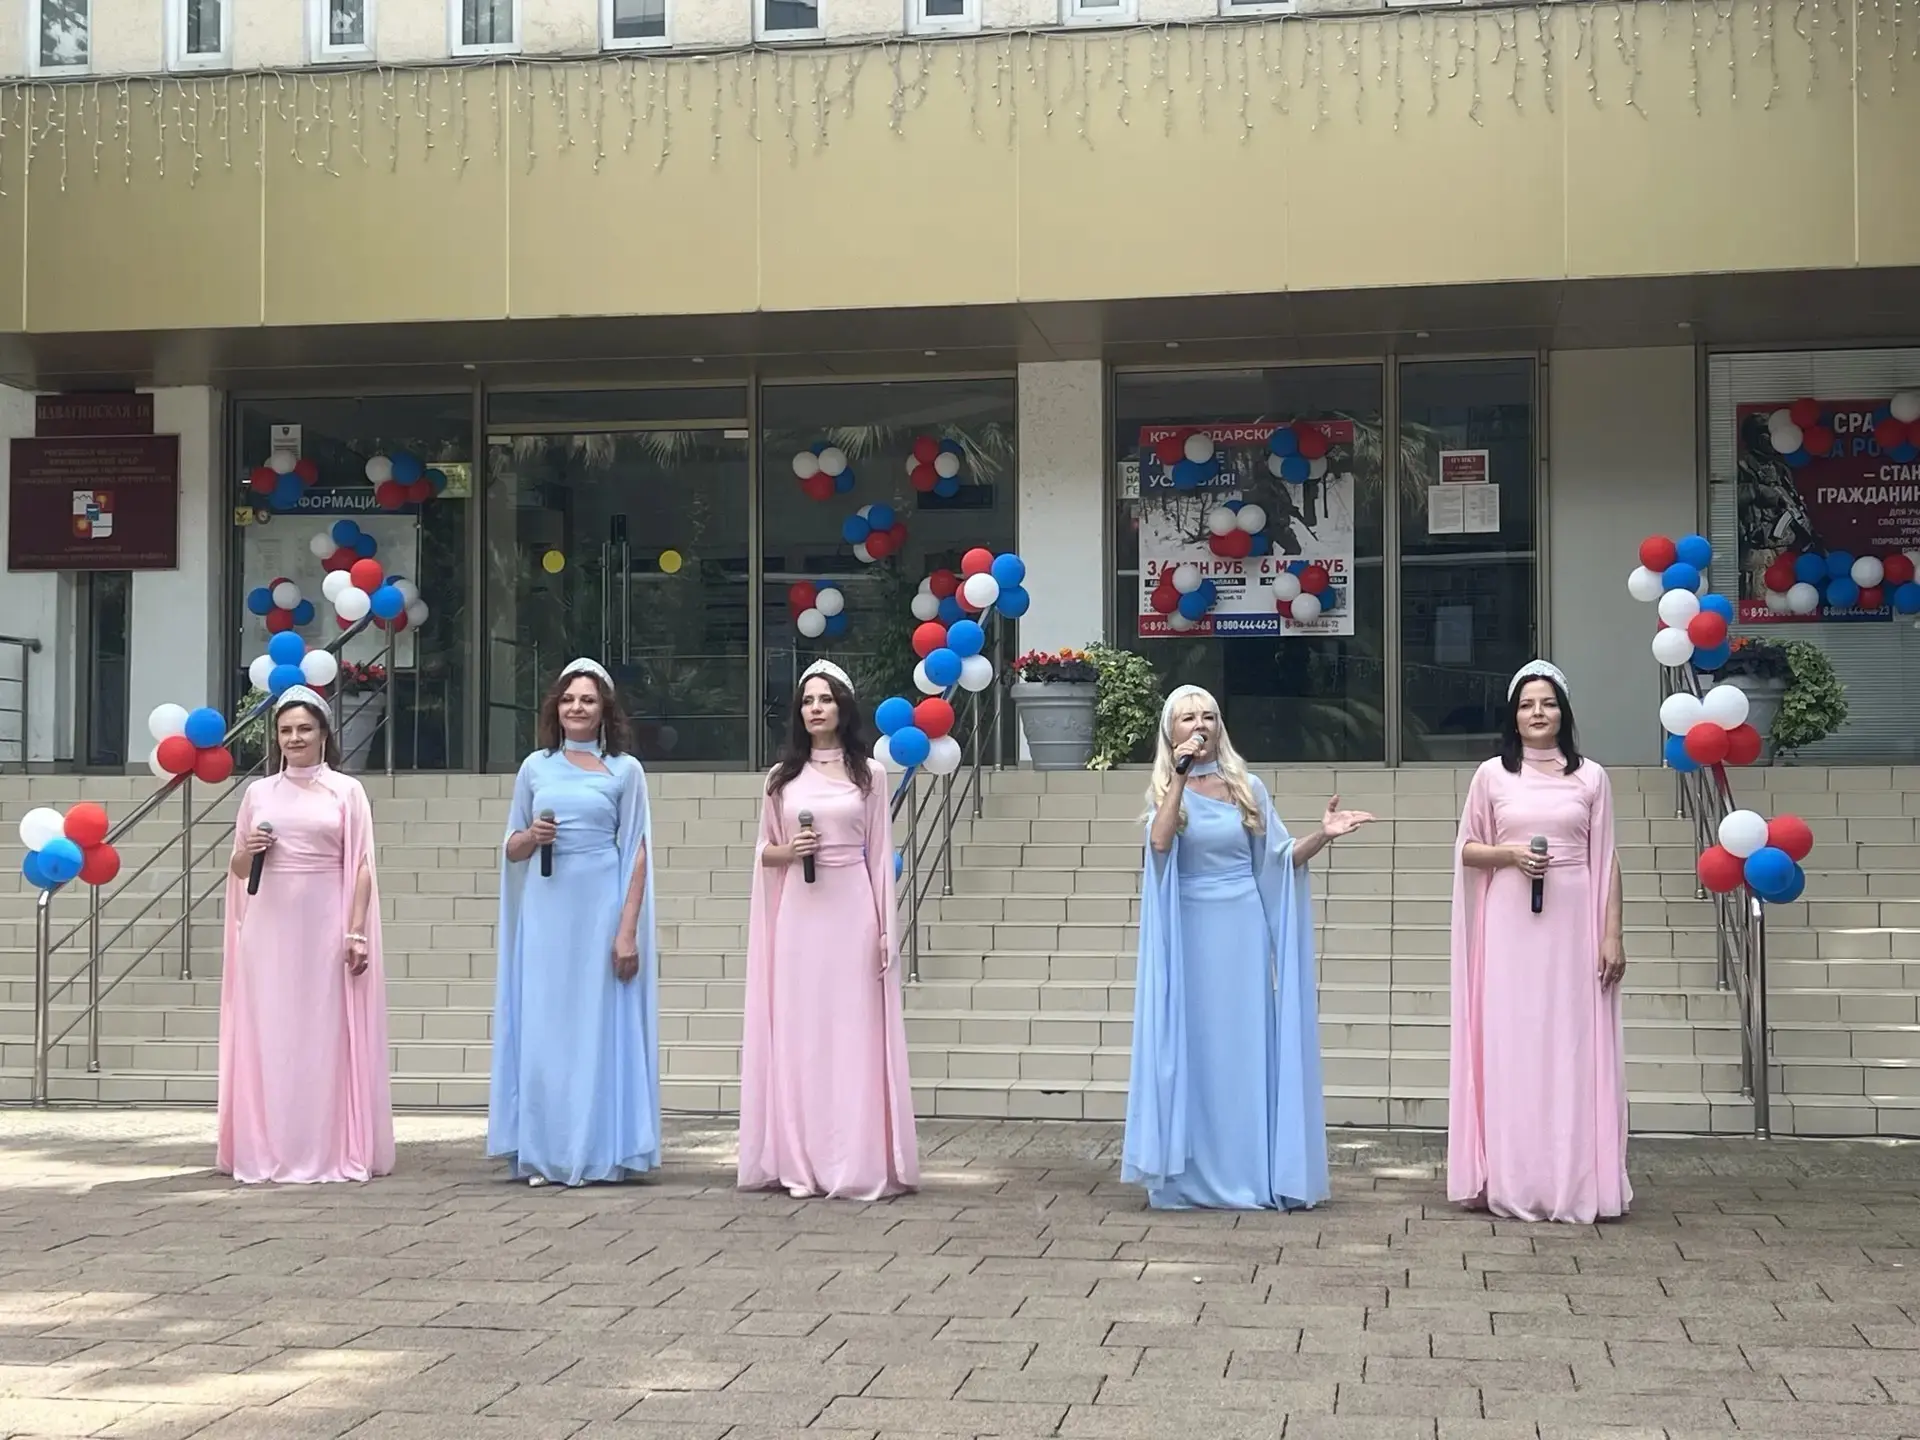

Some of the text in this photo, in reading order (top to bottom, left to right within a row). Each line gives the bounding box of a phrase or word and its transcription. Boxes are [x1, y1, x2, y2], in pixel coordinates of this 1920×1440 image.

[1833, 412, 1875, 434] СРА
[293, 495, 381, 510] ФОРМАЦИ
[1214, 560, 1247, 575] РУБ.
[1260, 558, 1270, 574] 6
